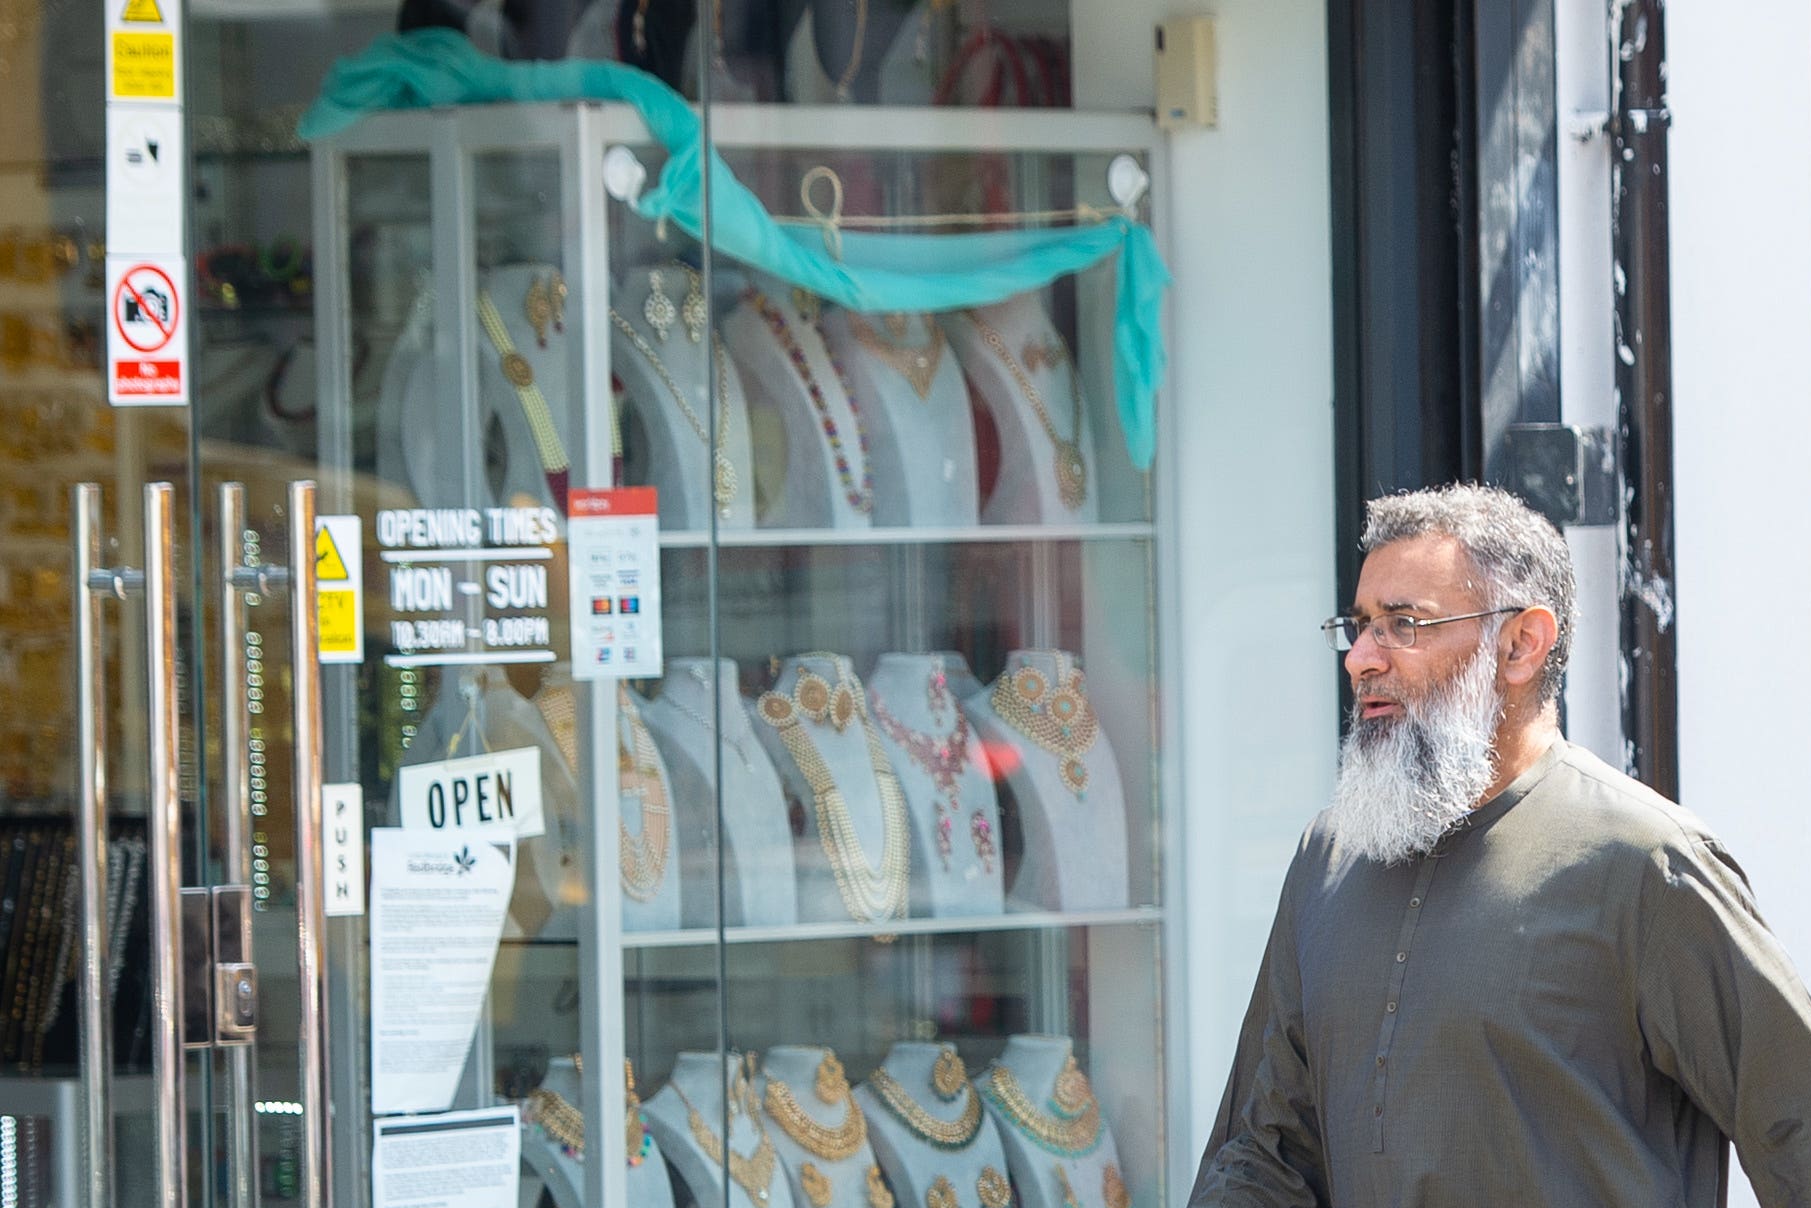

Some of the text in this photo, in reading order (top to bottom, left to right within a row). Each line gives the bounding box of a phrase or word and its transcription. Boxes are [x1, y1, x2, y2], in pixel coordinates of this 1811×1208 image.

[376, 507, 557, 547] OPENING TIMES
[389, 565, 547, 612] MON SUN
[429, 769, 513, 828] OPEN
